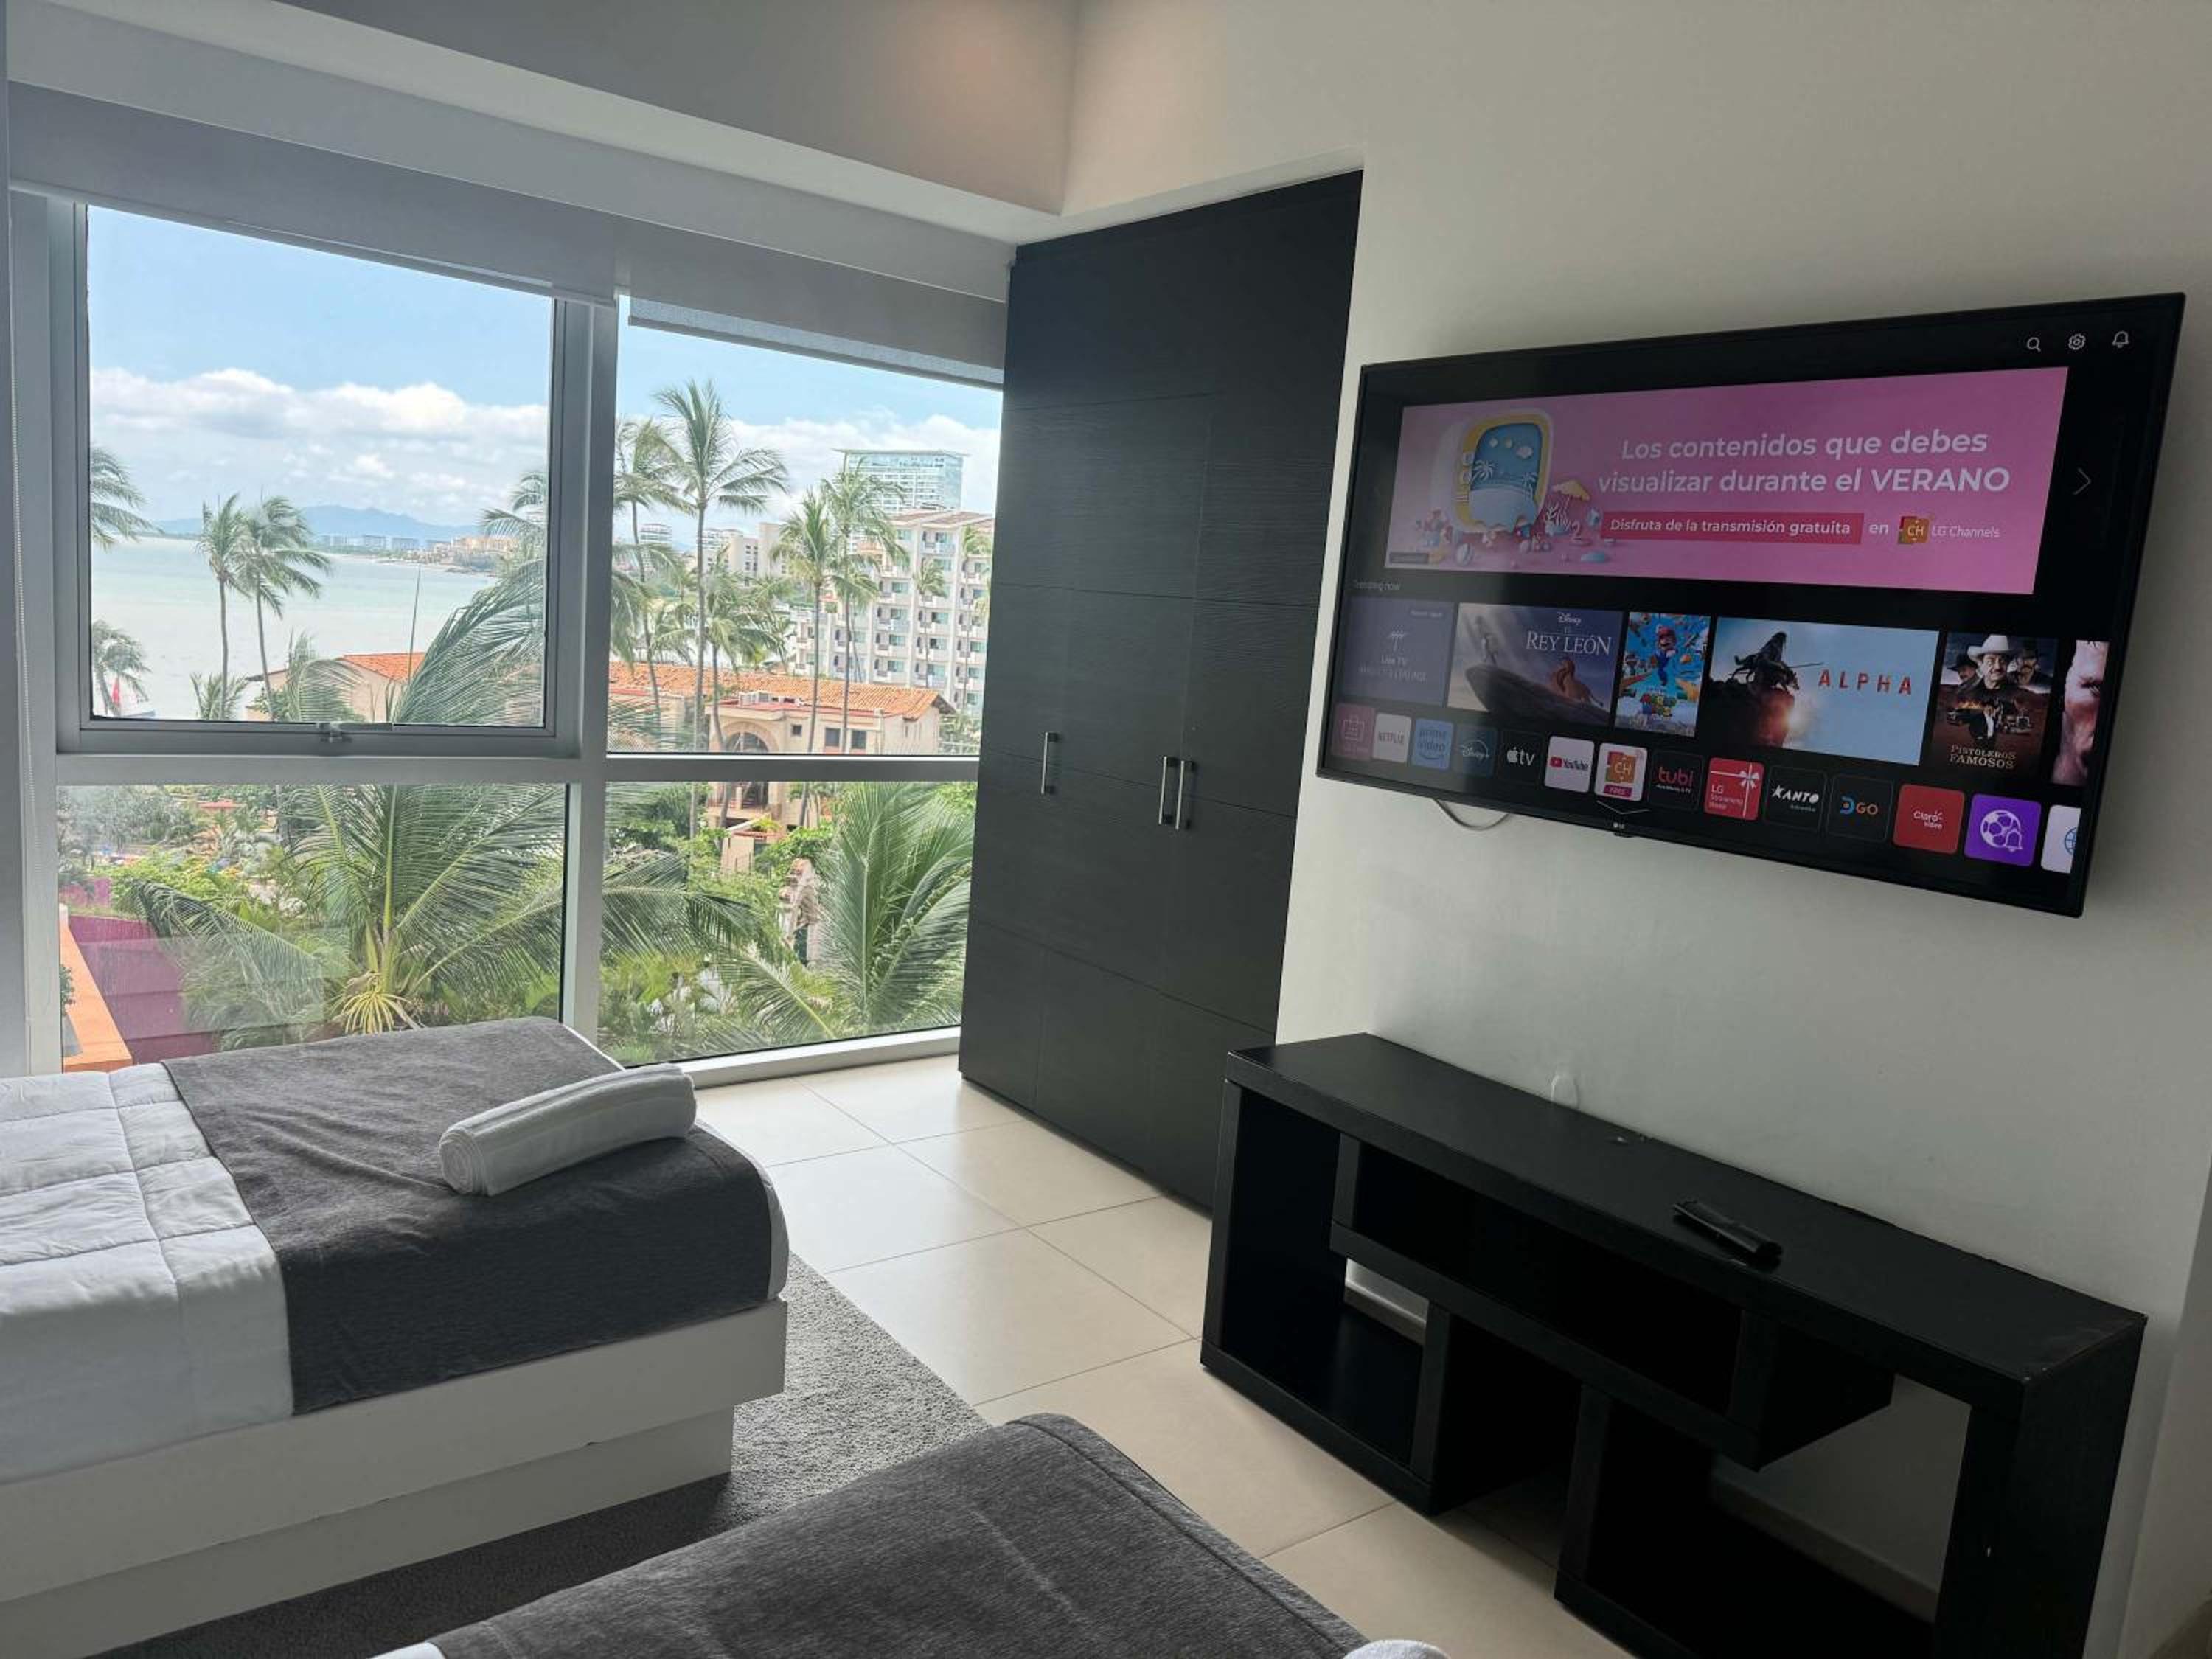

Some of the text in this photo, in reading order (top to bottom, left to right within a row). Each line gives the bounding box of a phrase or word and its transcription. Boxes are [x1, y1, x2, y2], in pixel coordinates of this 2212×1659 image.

[1622, 429, 1988, 460] Los contenidos que debes
[1598, 467, 2010, 493] visualizar durante el VERANO
[1610, 518, 1888, 536] Disfruta de la transmisión gratuita en
[1907, 524, 1925, 537] CH
[1932, 525, 2001, 538] LG Channels
[1526, 630, 1613, 655] REY LEÓN
[1818, 669, 1913, 695] ALPHA
[1950, 744, 2017, 759] PISTOLEROS
[1949, 753, 2016, 770] FAMOSOS
[1711, 784, 1724, 795] LG
[1772, 785, 1820, 804] KANTO
